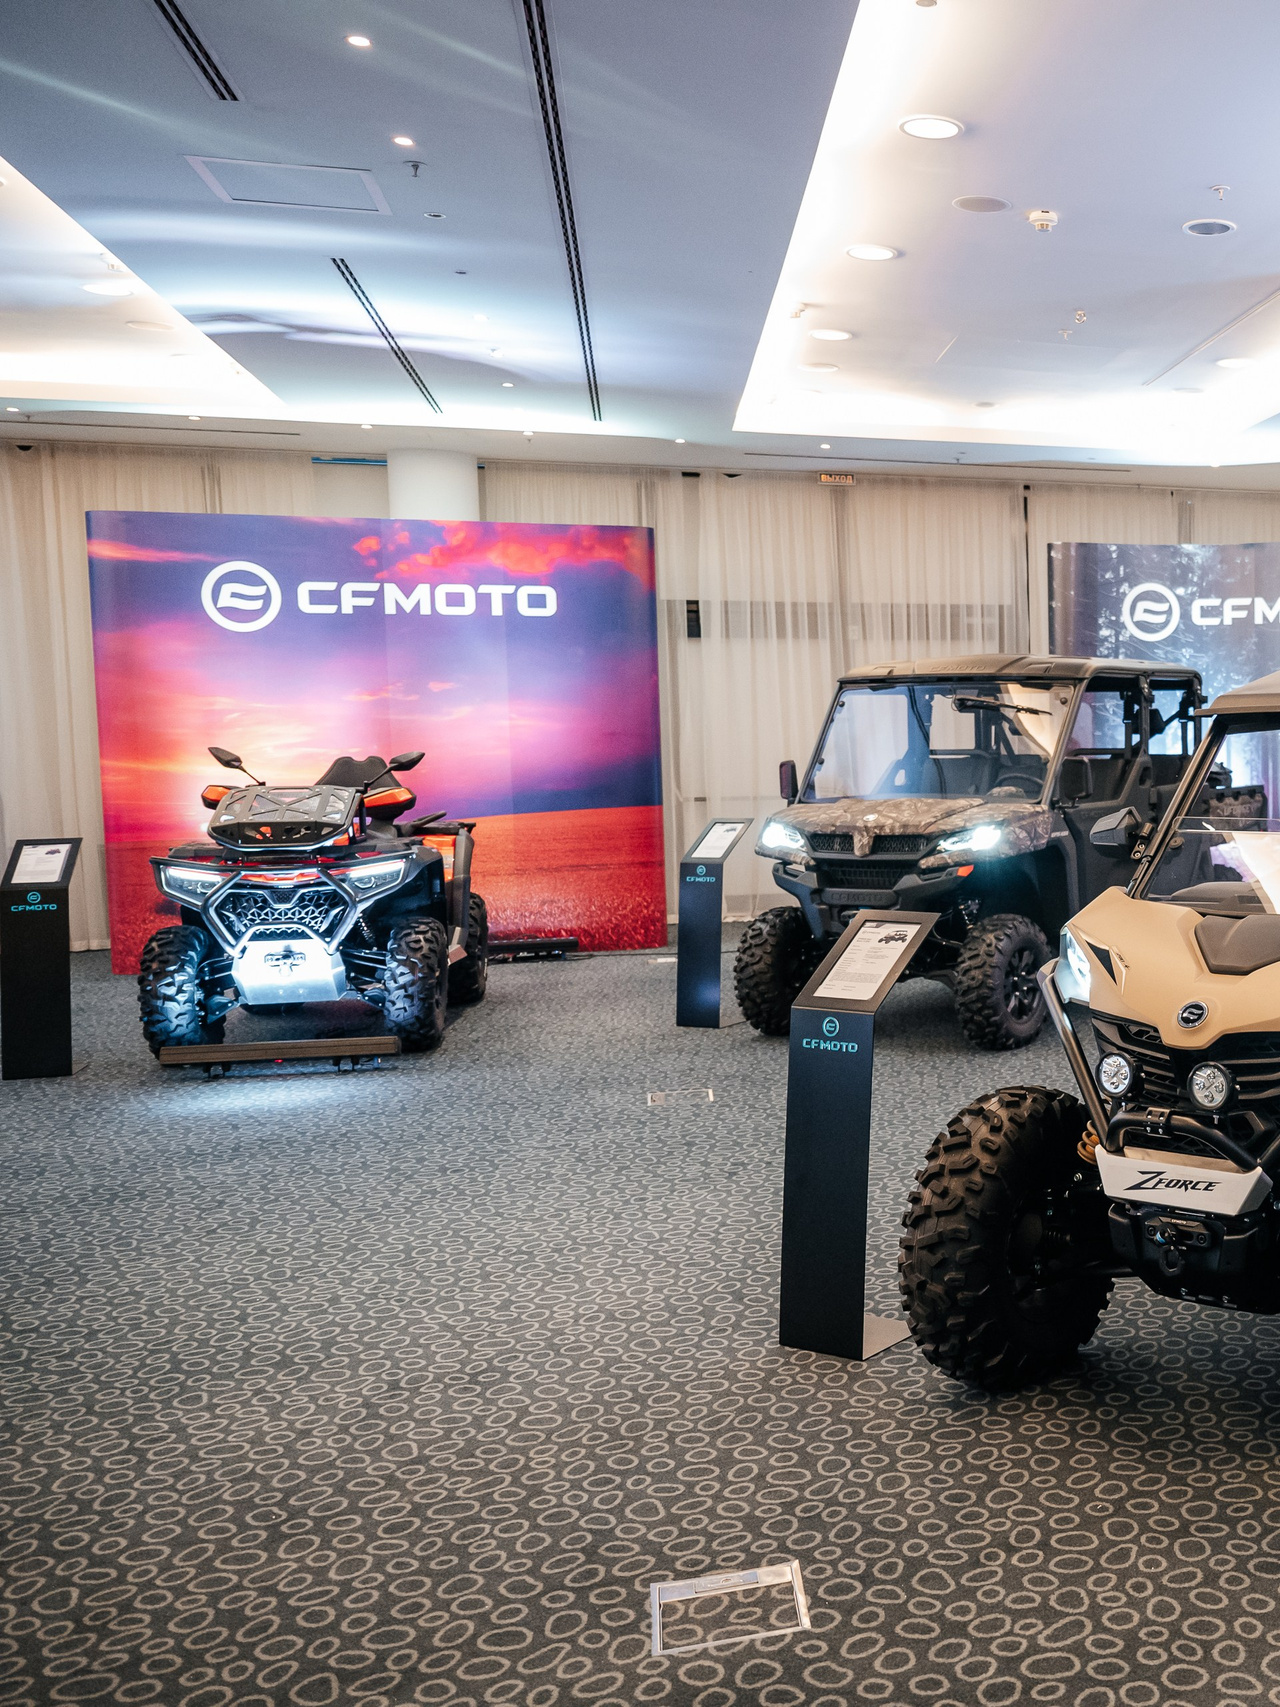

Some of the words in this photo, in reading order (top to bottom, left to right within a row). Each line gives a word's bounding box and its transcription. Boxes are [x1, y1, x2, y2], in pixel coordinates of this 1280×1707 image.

[820, 474, 853, 484] ВЫХОД
[297, 581, 557, 617] CFMOTO
[10, 903, 57, 912] CFMOTO
[802, 1038, 858, 1053] CFMOTO
